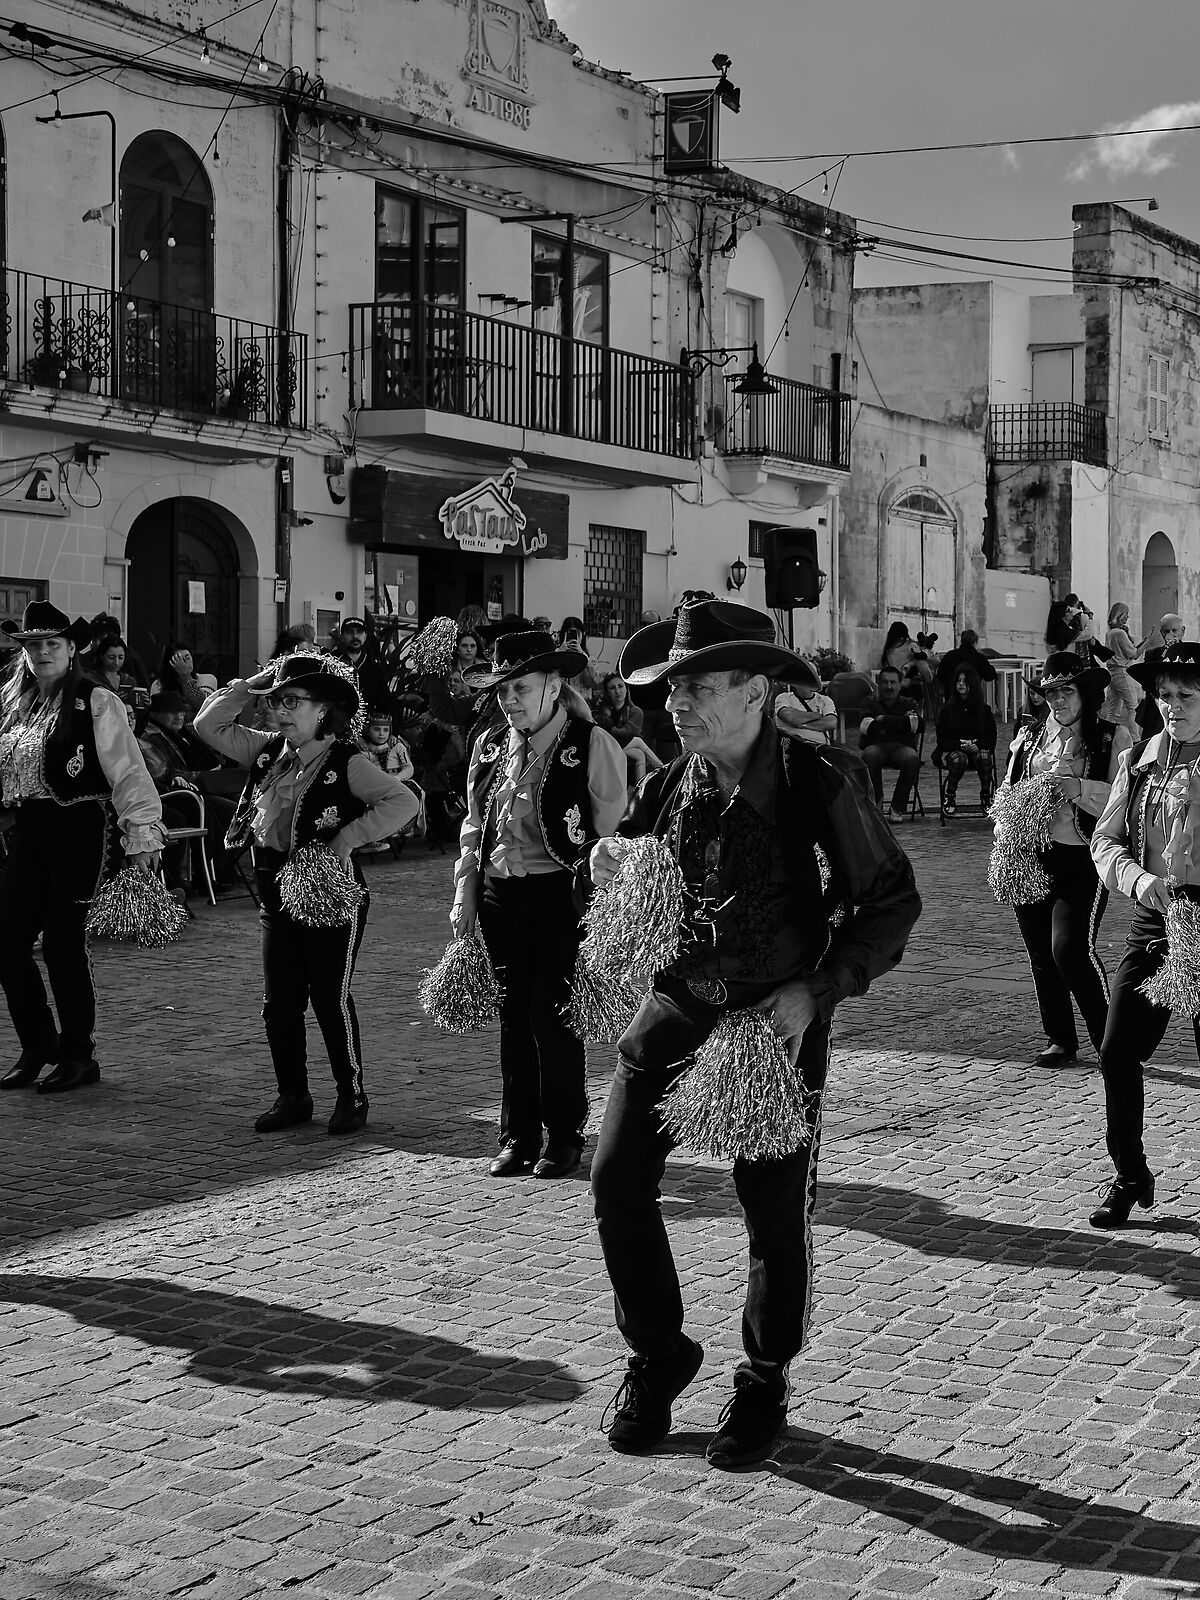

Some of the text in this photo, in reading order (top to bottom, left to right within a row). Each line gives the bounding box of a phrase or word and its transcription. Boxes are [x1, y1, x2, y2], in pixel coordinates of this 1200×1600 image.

[481, 54, 520, 82] P N
[521, 527, 548, 555] Lab
